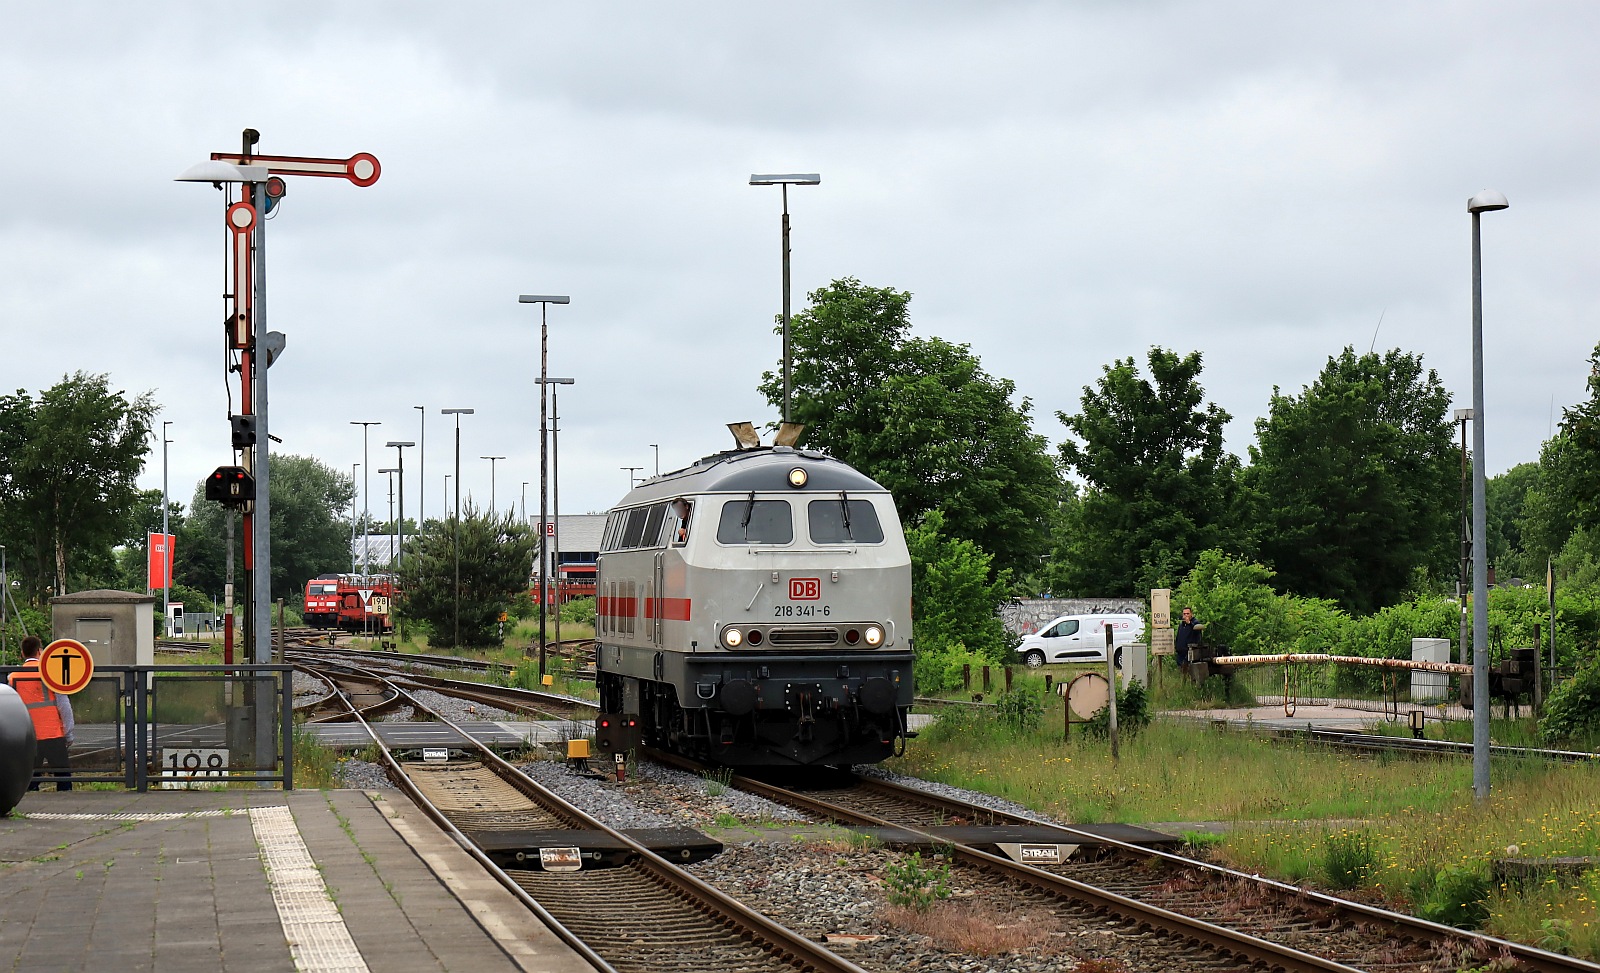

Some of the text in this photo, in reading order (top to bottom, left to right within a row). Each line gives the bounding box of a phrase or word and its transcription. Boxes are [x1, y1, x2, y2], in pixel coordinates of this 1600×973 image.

[793, 582, 816, 596] DB
[373, 597, 386, 605] 198
[774, 605, 831, 617] 218 341-6
[1021, 849, 1058, 858] STRAIL
